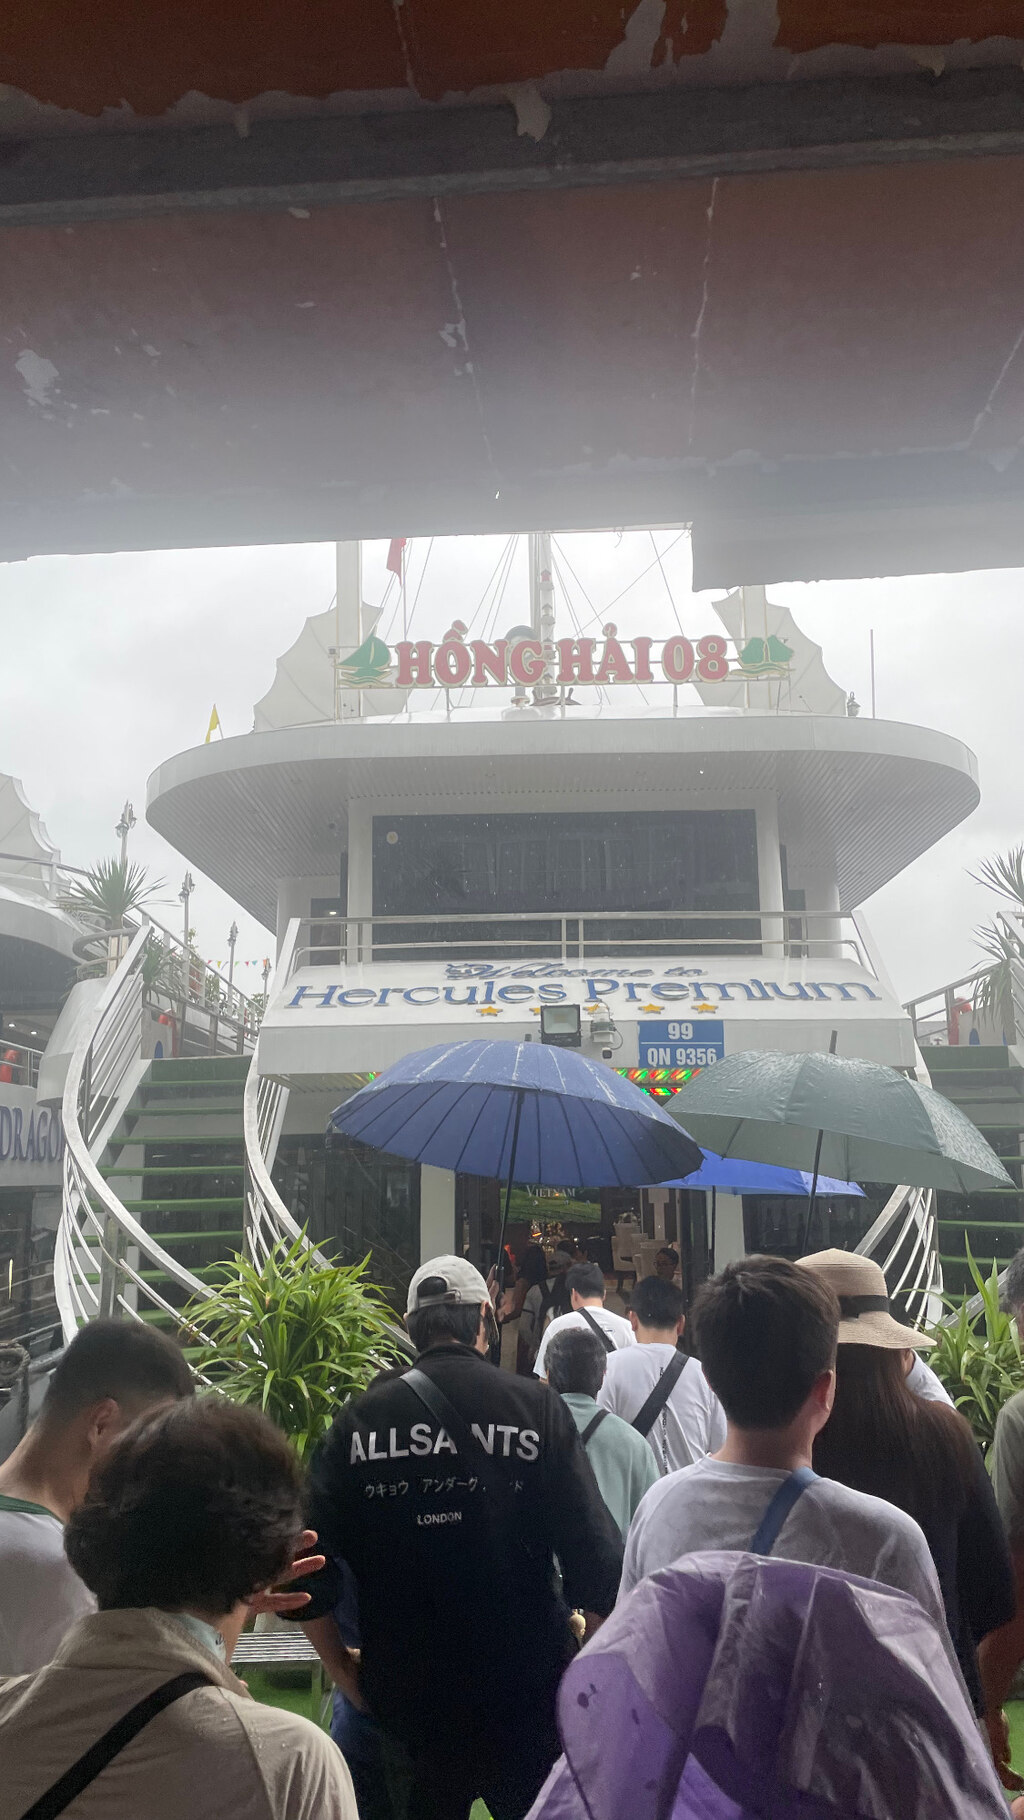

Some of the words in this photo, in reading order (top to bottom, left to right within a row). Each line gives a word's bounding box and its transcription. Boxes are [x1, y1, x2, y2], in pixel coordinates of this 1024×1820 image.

[394, 619, 547, 688] HỒNG
[556, 621, 654, 686] HẢI
[662, 634, 729, 684] 08
[445, 962, 654, 980] Welcome
[664, 967, 708, 978] to
[284, 981, 567, 1008] Hercules
[668, 1022, 693, 1040] 99
[647, 1048, 671, 1067] QN
[676, 1048, 717, 1066] 9356
[350, 1422, 540, 1465] ALLSANTS
[417, 1511, 463, 1527] LONDON
